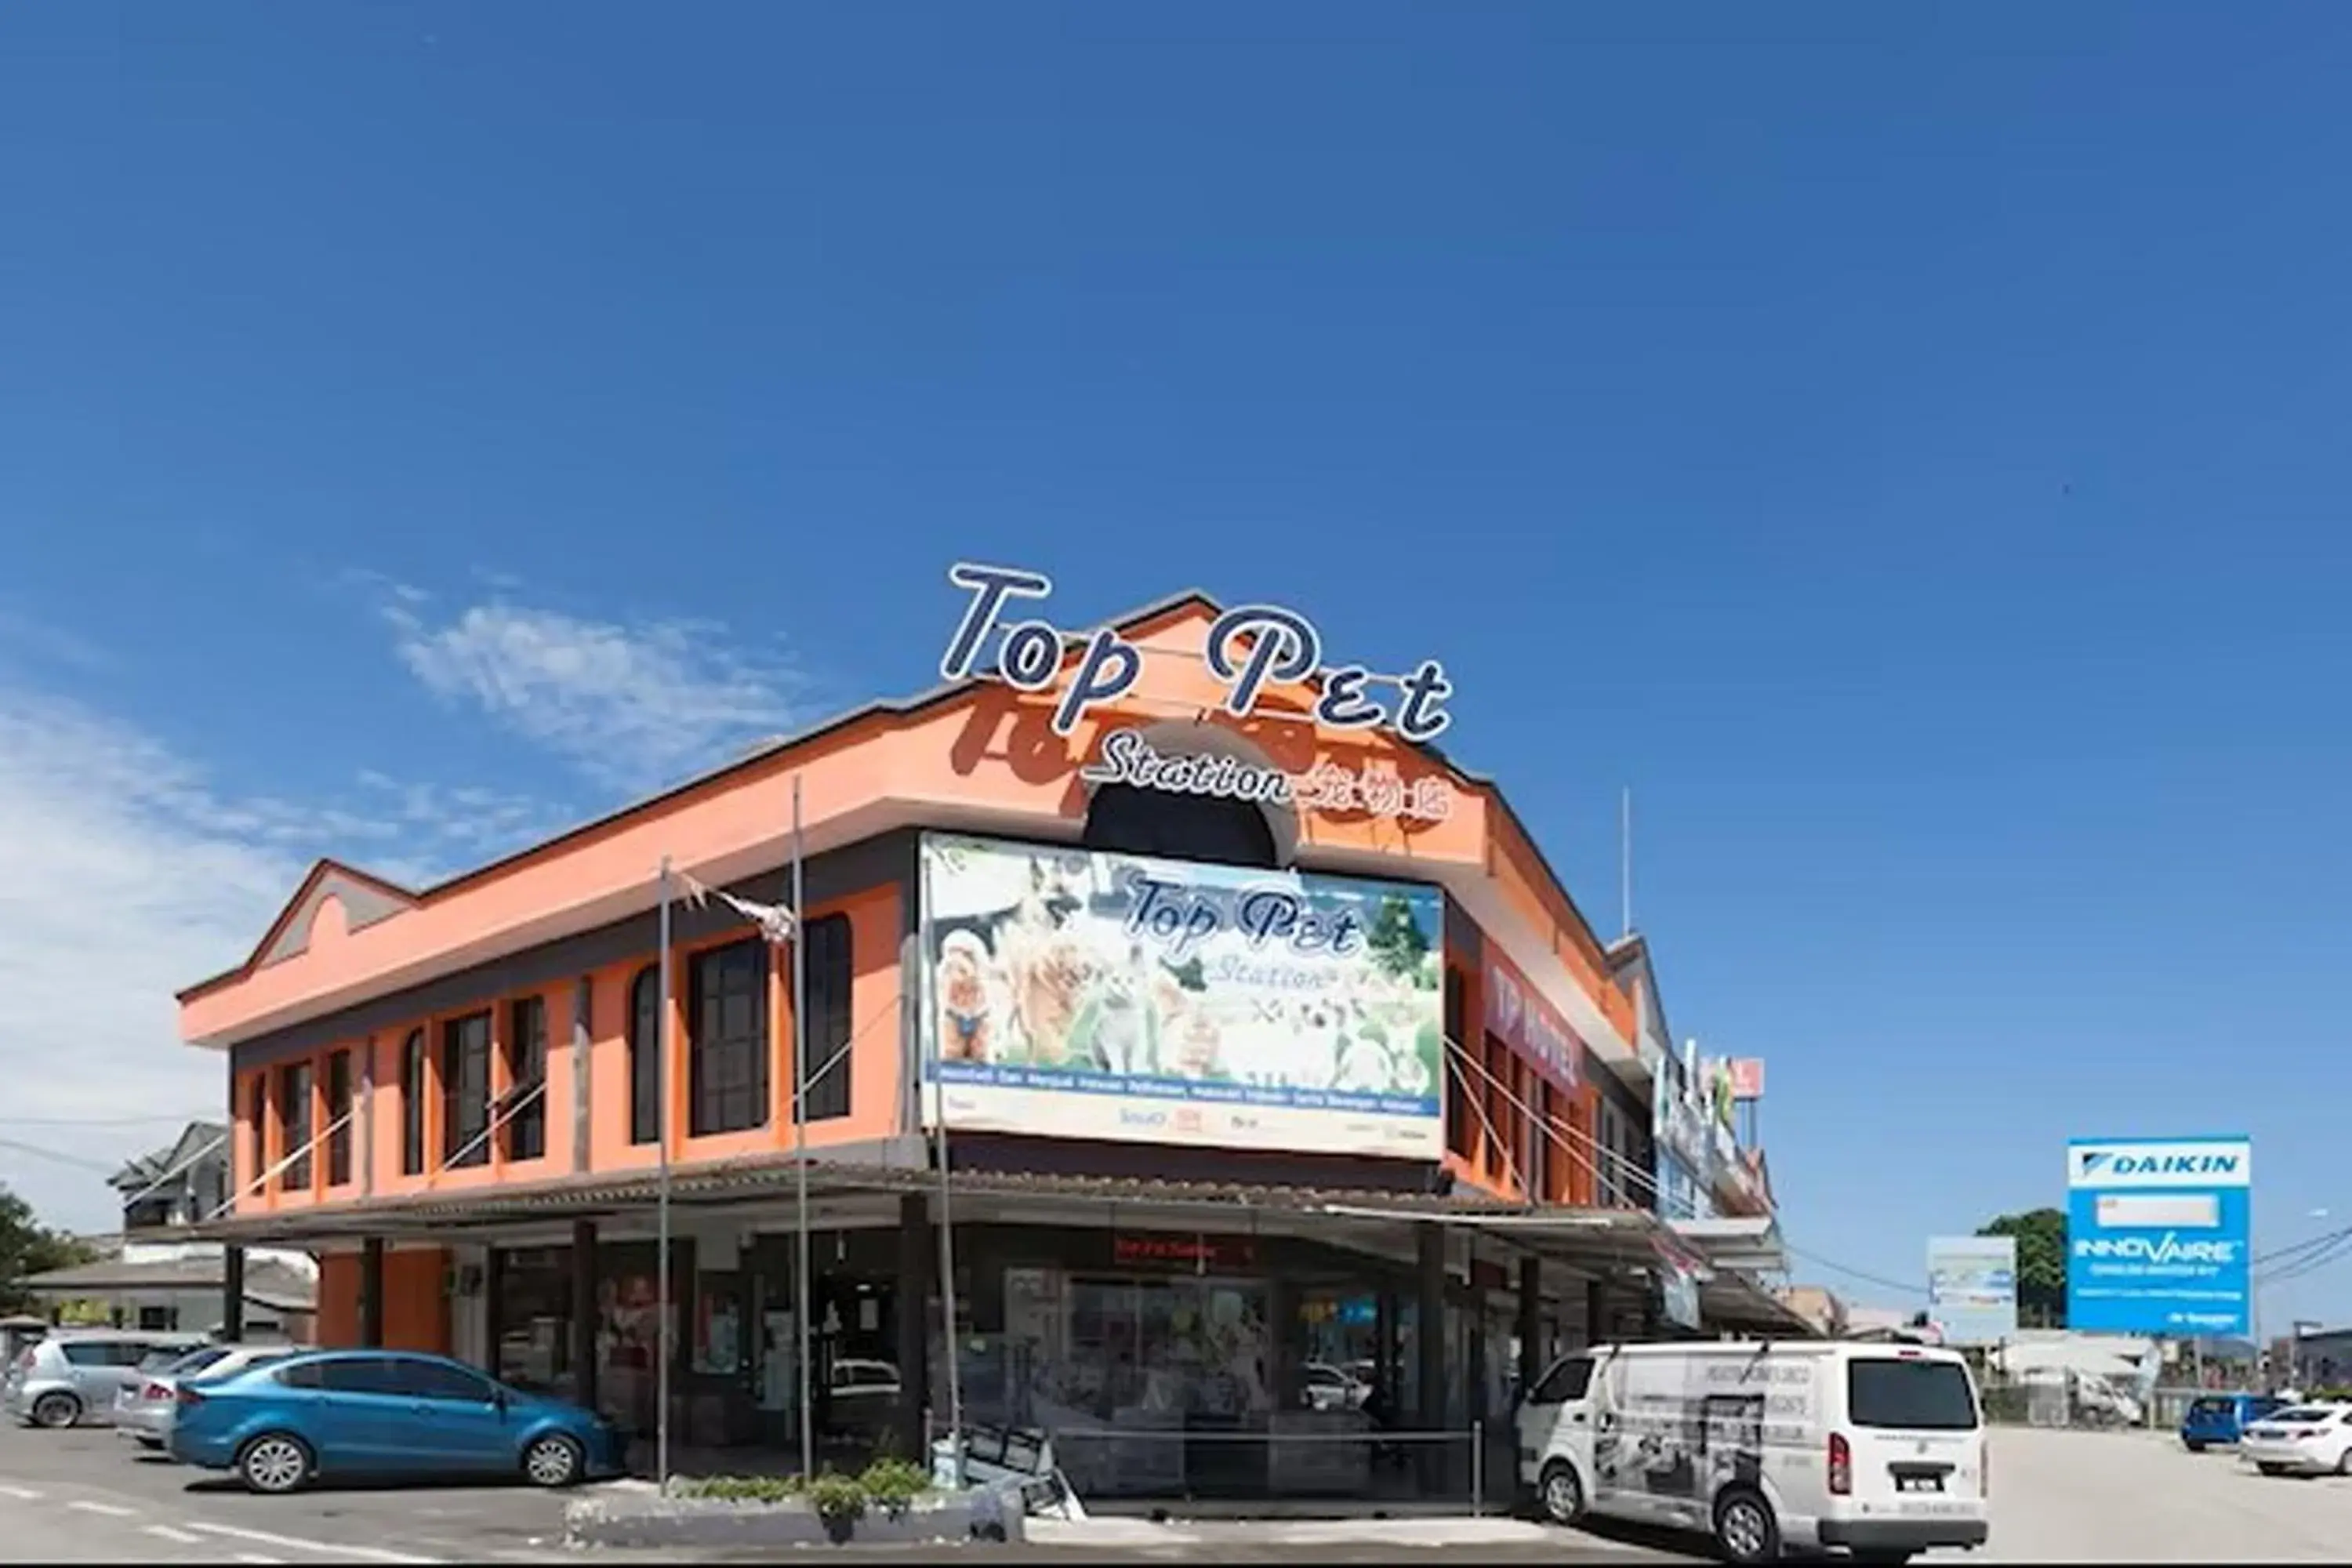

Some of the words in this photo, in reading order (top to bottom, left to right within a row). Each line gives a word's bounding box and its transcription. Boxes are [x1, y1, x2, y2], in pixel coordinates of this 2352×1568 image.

[942, 562, 1142, 735] Top
[1203, 604, 1454, 742] Pet
[1082, 728, 1294, 804] Station
[1129, 876, 1220, 956] Top
[1240, 887, 1359, 955] Pet
[2113, 1155, 2238, 1173] DAIKIN
